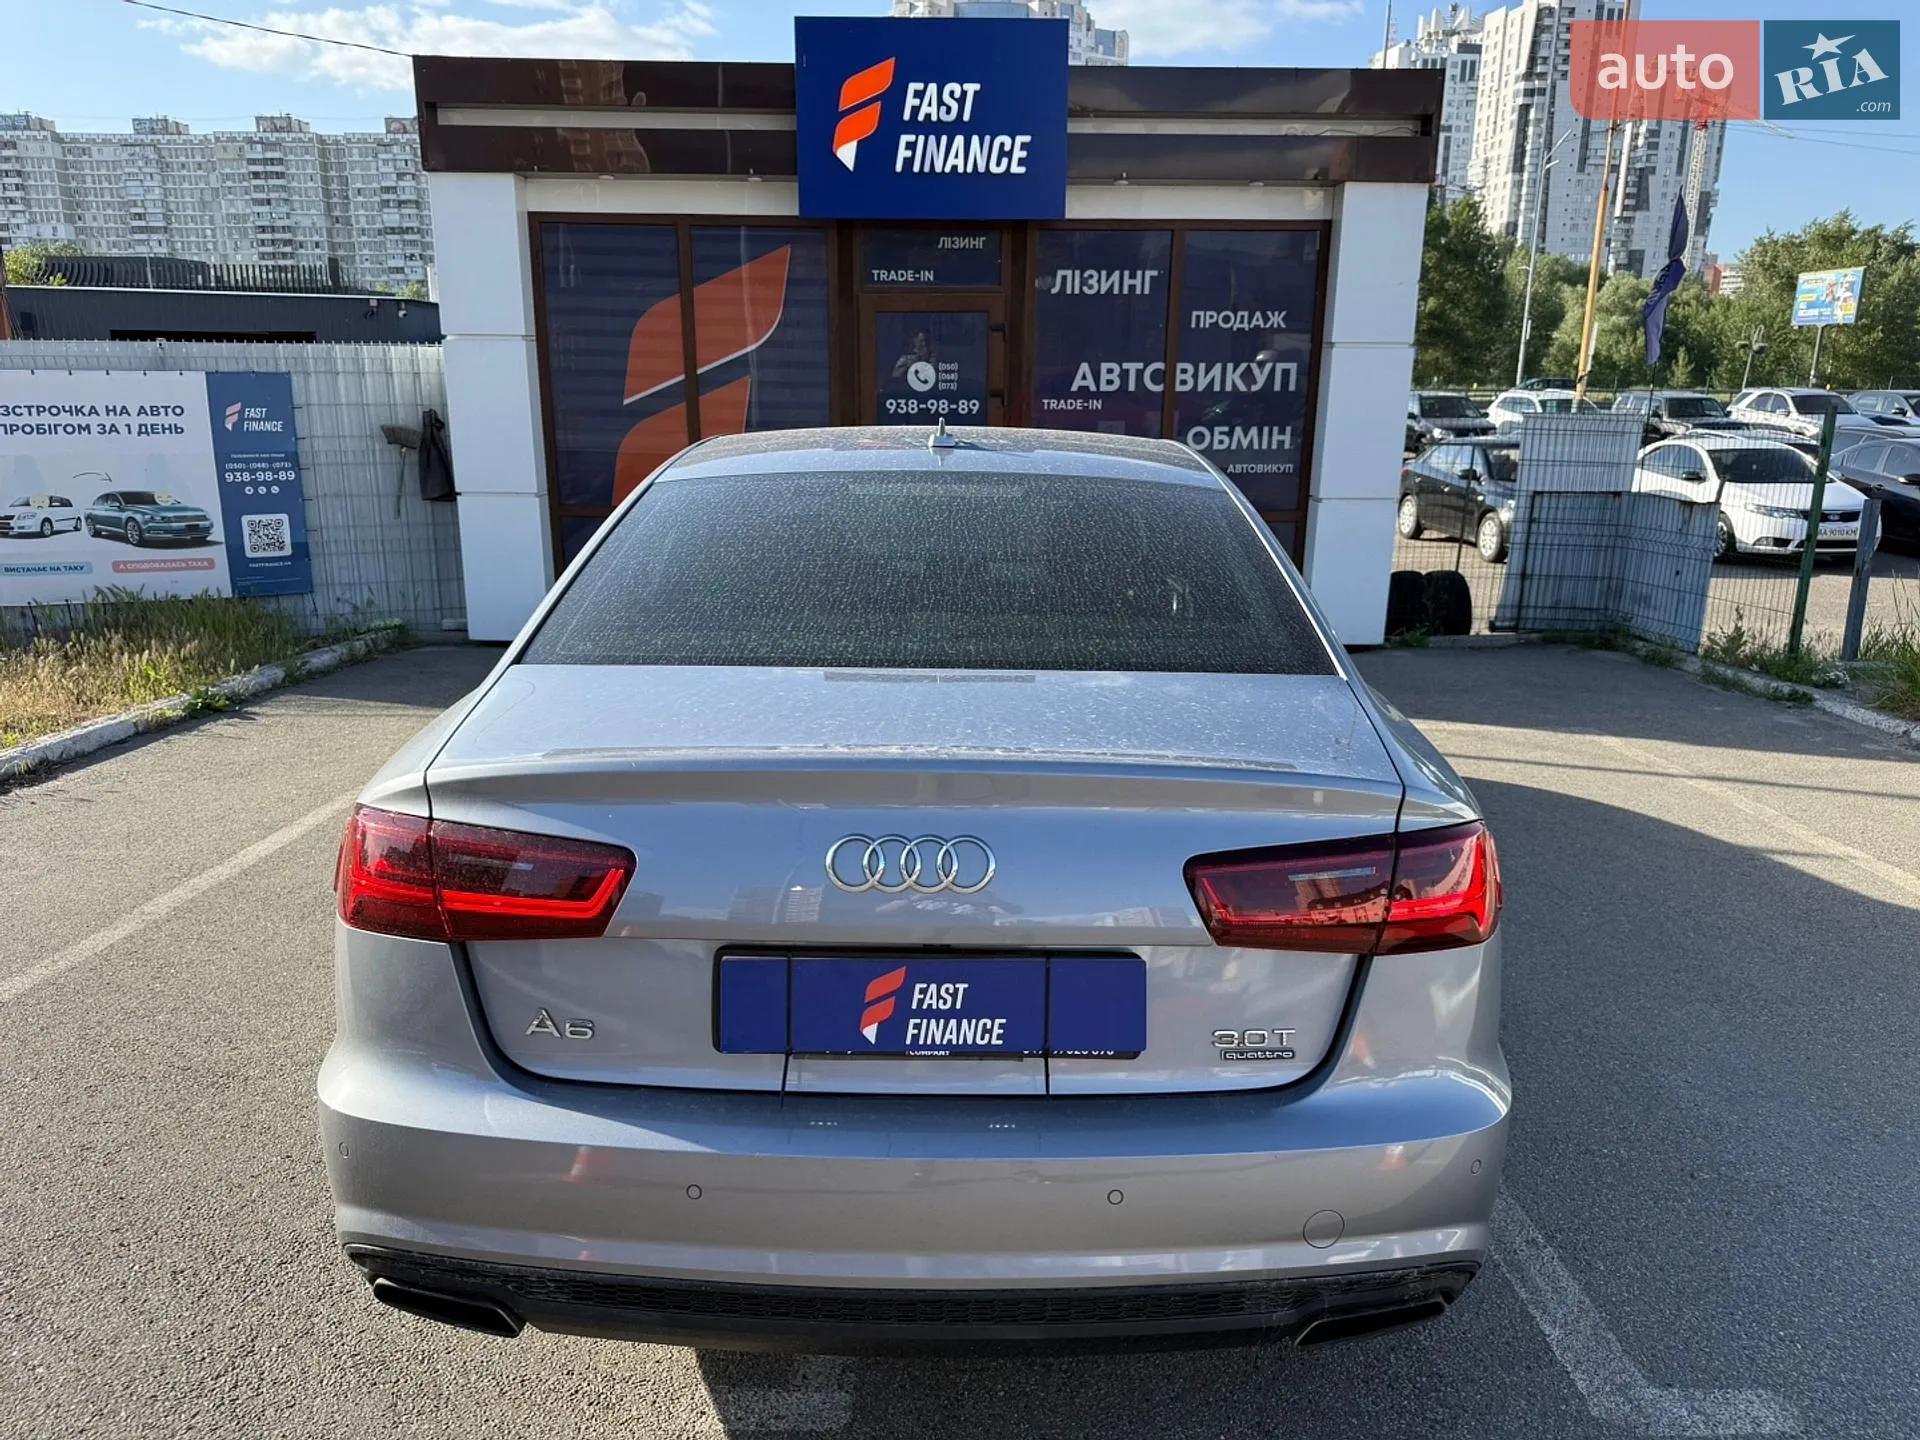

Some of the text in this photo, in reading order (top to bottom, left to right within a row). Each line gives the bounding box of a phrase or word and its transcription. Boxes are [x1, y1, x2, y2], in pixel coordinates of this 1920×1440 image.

[902, 82, 981, 122] FAST
[895, 134, 1032, 174] FINANCE
[938, 236, 986, 249] ЛІЗИНГ
[871, 269, 934, 281] TRADE-IN
[1050, 269, 1158, 295] ЛІЗИНГ
[1190, 310, 1288, 331] ПРОДАЖ
[105, 404, 131, 417] НА
[136, 404, 185, 417] АВТО
[885, 399, 980, 415] 938-98-89
[1042, 399, 1102, 410] TRADE-IN
[244, 408, 268, 418] FAST
[97, 423, 121, 435] ЗА
[125, 423, 132, 435] 1
[137, 423, 185, 437] ДЕНЬ
[243, 420, 284, 432] FINANCE
[1186, 426, 1292, 450] ОБМІН
[1226, 463, 1294, 474] АВТОВИКУП
[224, 470, 295, 483] 938-98-89
[911, 982, 969, 1010] FAST
[525, 1007, 595, 1039] A6
[905, 1018, 1007, 1045] FINANCE
[1225, 1050, 1293, 1060] quattro
